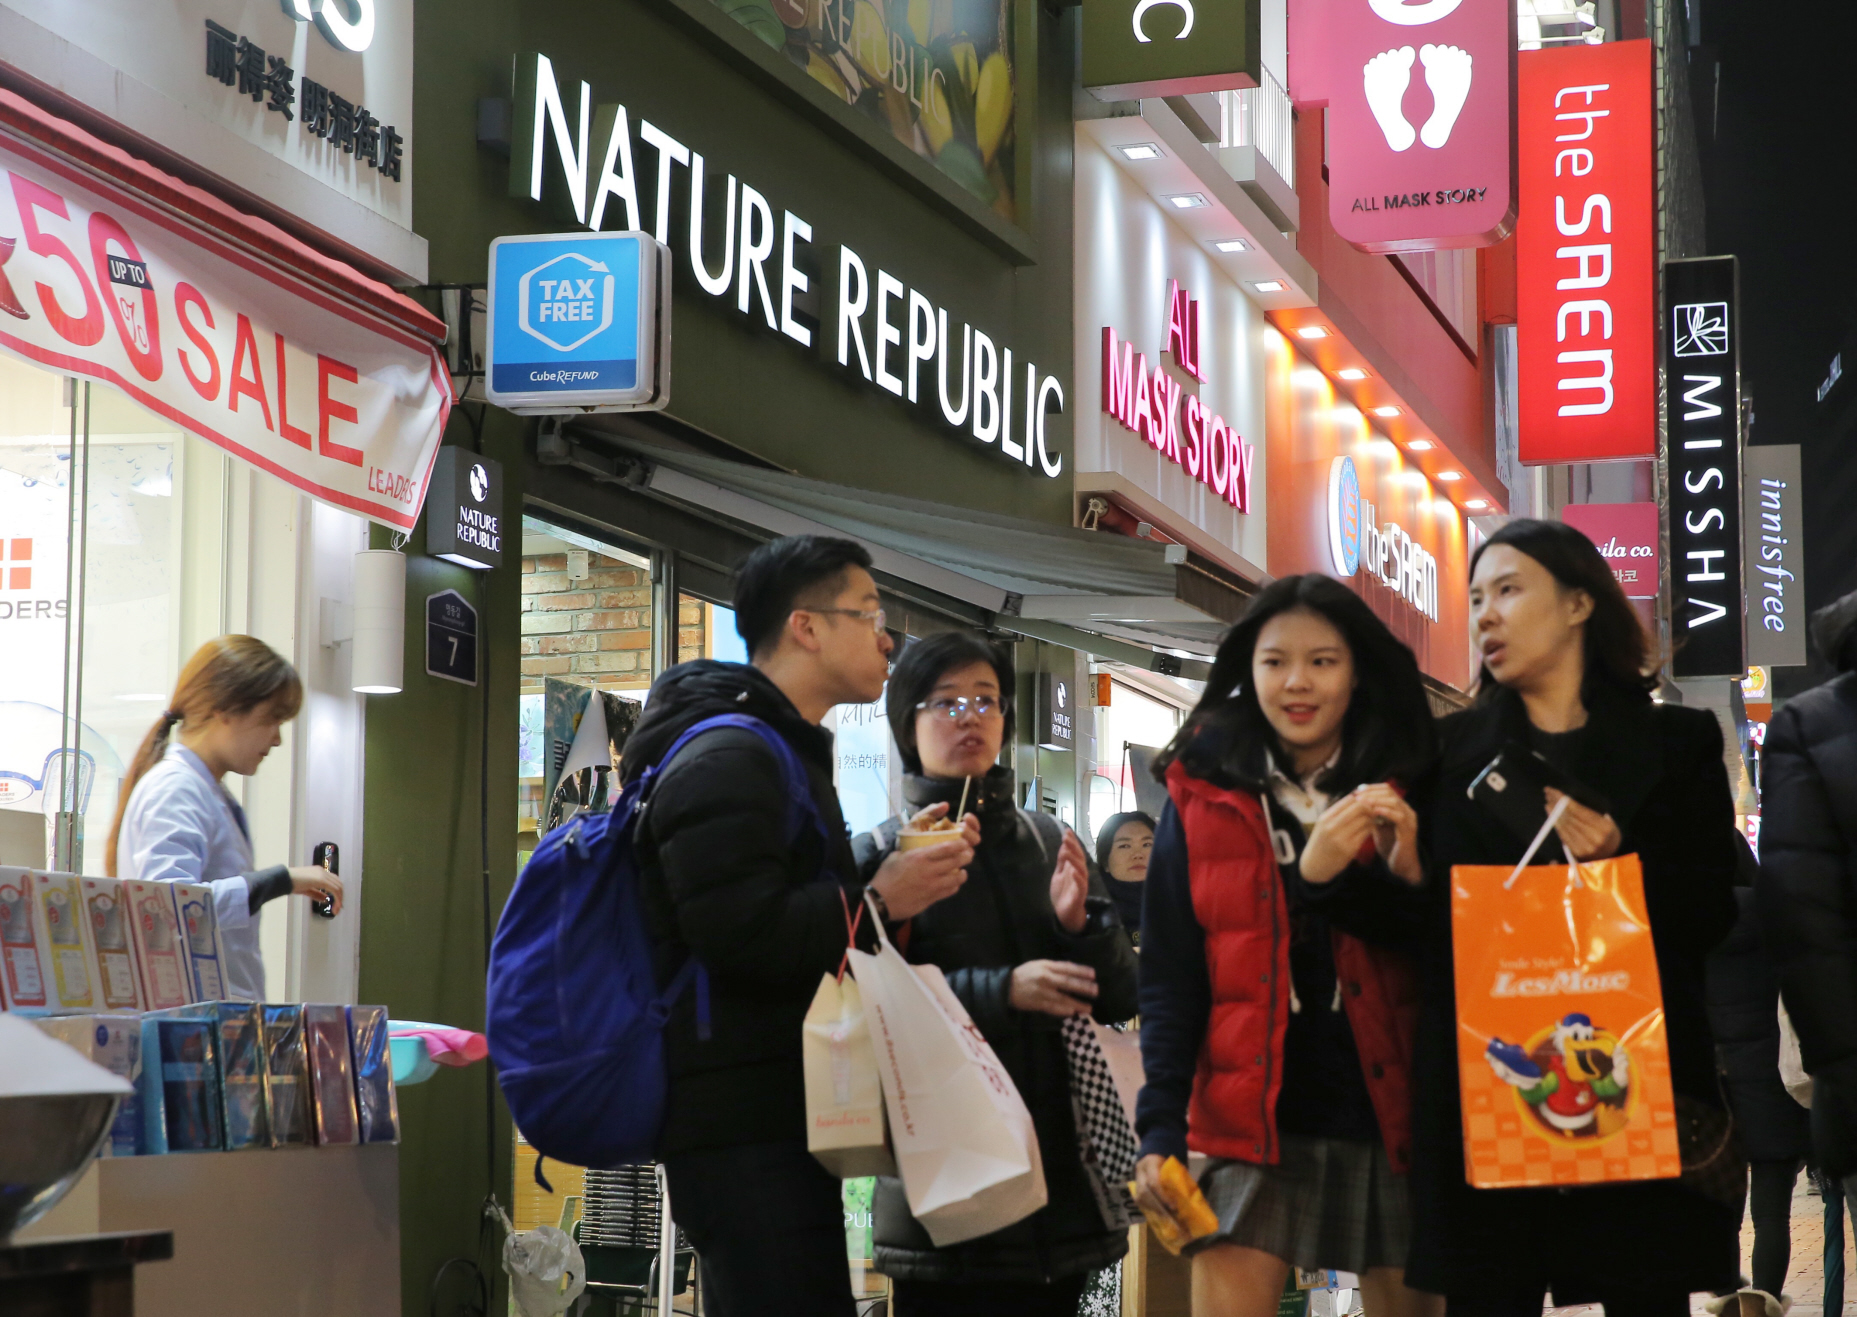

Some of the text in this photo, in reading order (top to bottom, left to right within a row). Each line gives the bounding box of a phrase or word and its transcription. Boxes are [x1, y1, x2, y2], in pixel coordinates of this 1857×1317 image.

[1555, 84, 1610, 177] the
[1351, 186, 1487, 213] ALL MASK STORY
[110, 260, 145, 284] UP TO
[531, 52, 1064, 478] NATURE REPUBLIC
[539, 279, 595, 300] TAX
[540, 301, 594, 322] FREE
[1163, 279, 1208, 384] ALL
[174, 282, 363, 467] SALE
[1103, 327, 1255, 515] MASK STORY
[1683, 374, 1727, 628] MISSHA
[460, 505, 498, 534] NATURE
[457, 523, 501, 552] REPUBLIC
[1630, 545, 1654, 558] co.
[1756, 477, 1794, 632] innisfree
[448, 636, 458, 666] 7
[1053, 711, 1071, 728] NATURE
